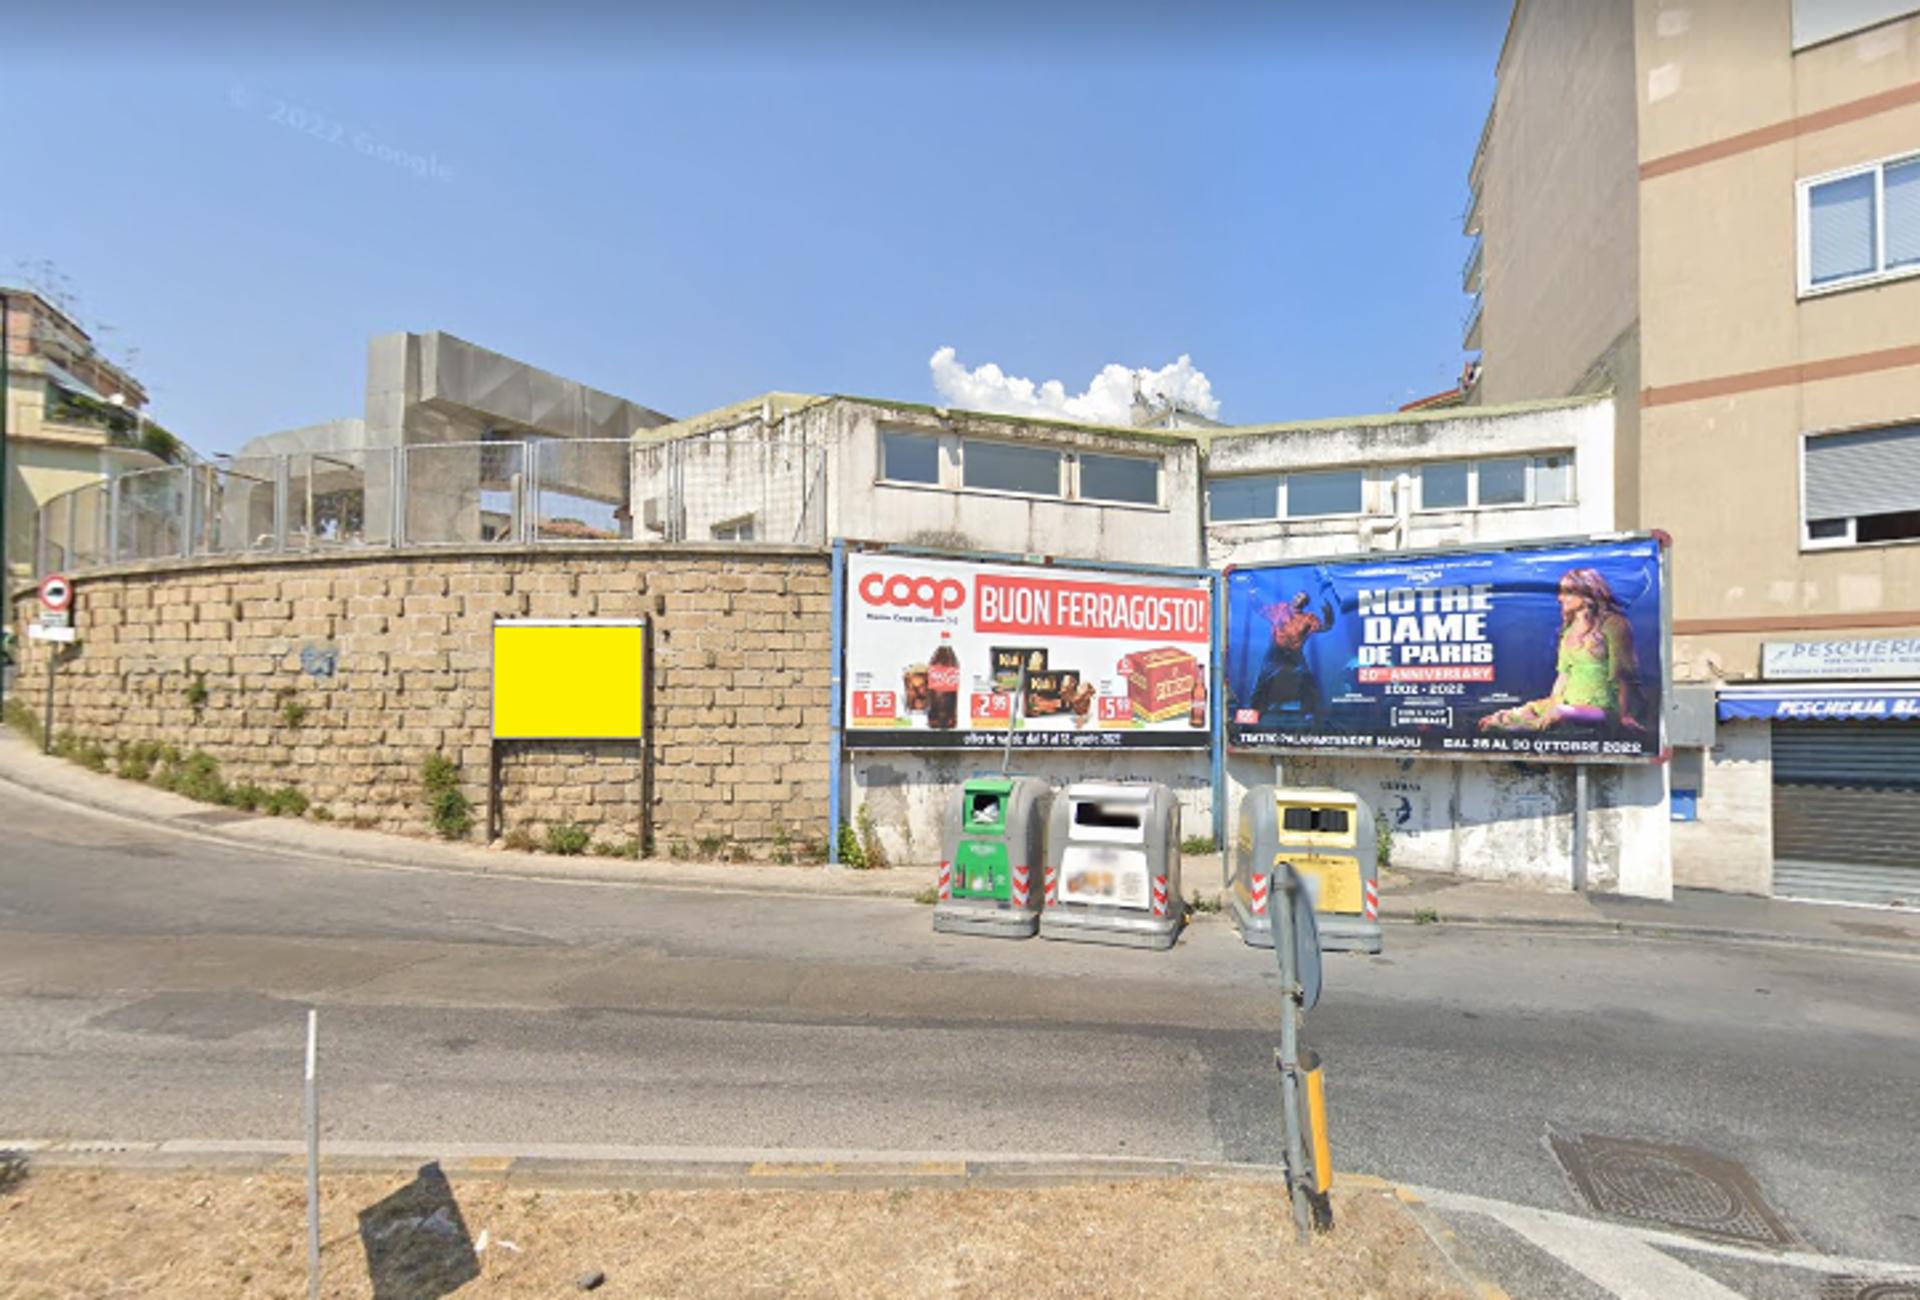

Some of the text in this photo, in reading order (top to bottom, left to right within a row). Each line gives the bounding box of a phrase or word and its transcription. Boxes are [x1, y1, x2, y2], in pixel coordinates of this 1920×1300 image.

[858, 572, 966, 616] coop
[1357, 583, 1494, 615] NOTRE
[980, 585, 1205, 633] BUON FERRAGOSTO!
[1363, 615, 1486, 643] DAME
[1357, 643, 1493, 665] DE PARIS
[1390, 667, 1491, 681] ANNIVERSARY
[1429, 683, 1465, 695] 2022
[1777, 701, 1887, 715] PESCHERIA
[1377, 736, 1422, 748] NAPOLI
[1443, 738, 1469, 748] DAL
[1492, 739, 1510, 750] AL
[1533, 740, 1599, 753] OTTOBRE
[1602, 741, 1642, 753] 2022
